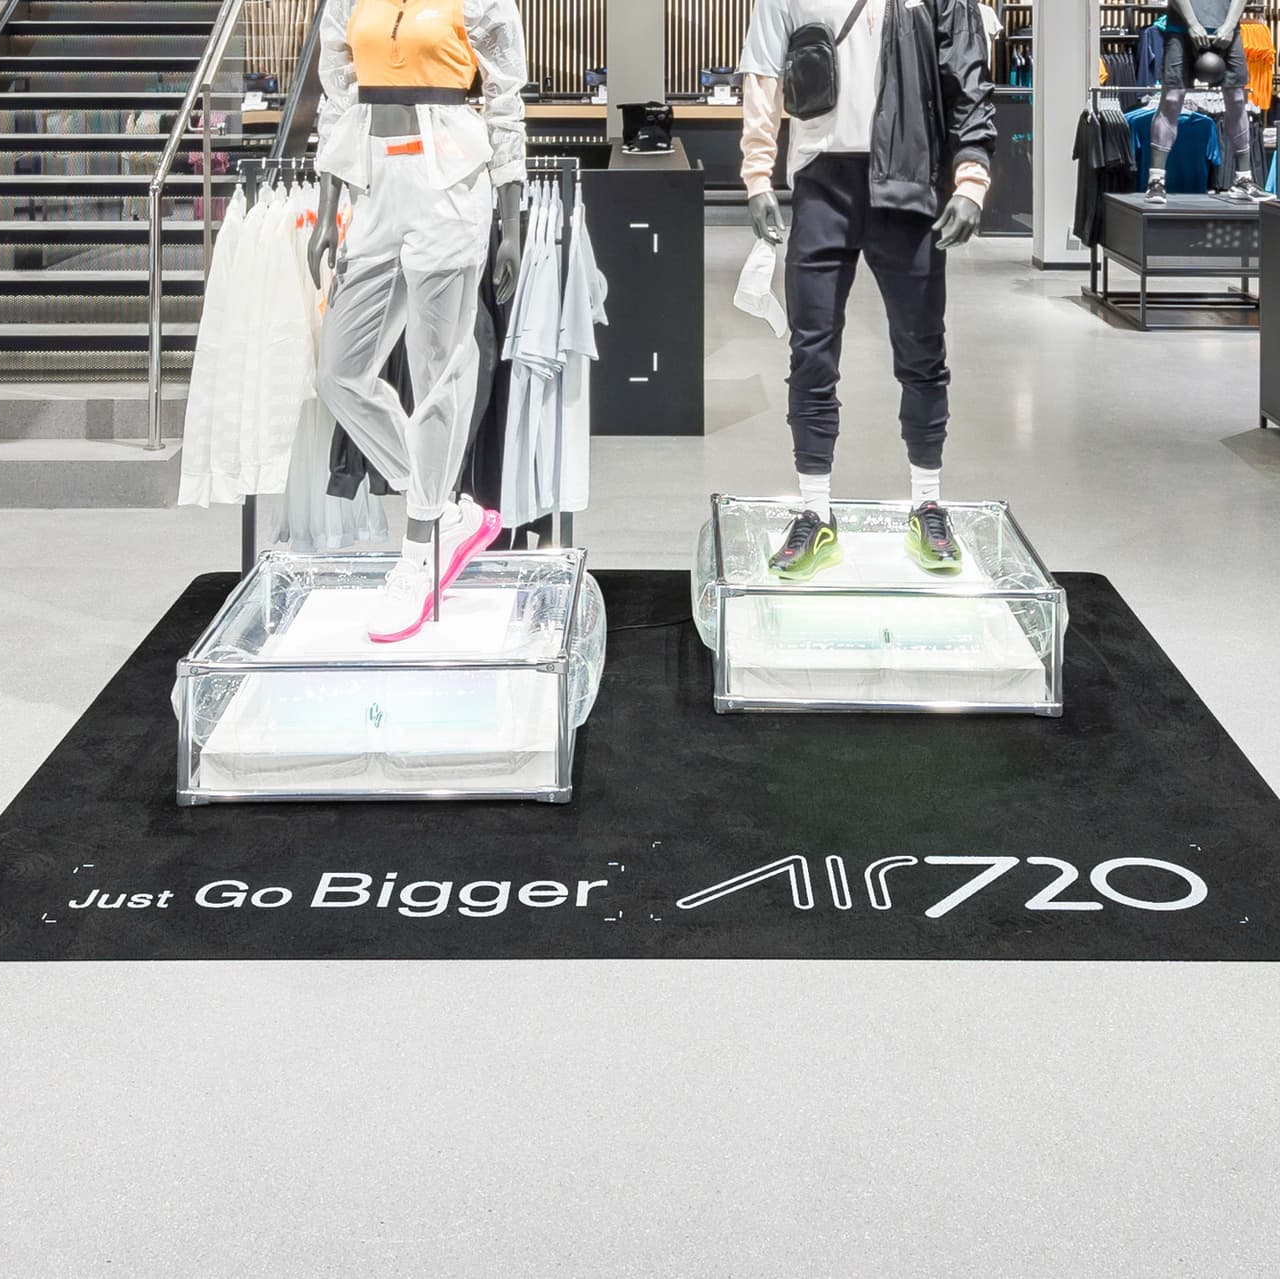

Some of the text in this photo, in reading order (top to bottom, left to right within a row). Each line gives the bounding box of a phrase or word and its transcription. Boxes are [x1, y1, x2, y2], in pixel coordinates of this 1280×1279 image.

[69, 872, 608, 917] Just Go Bigger
